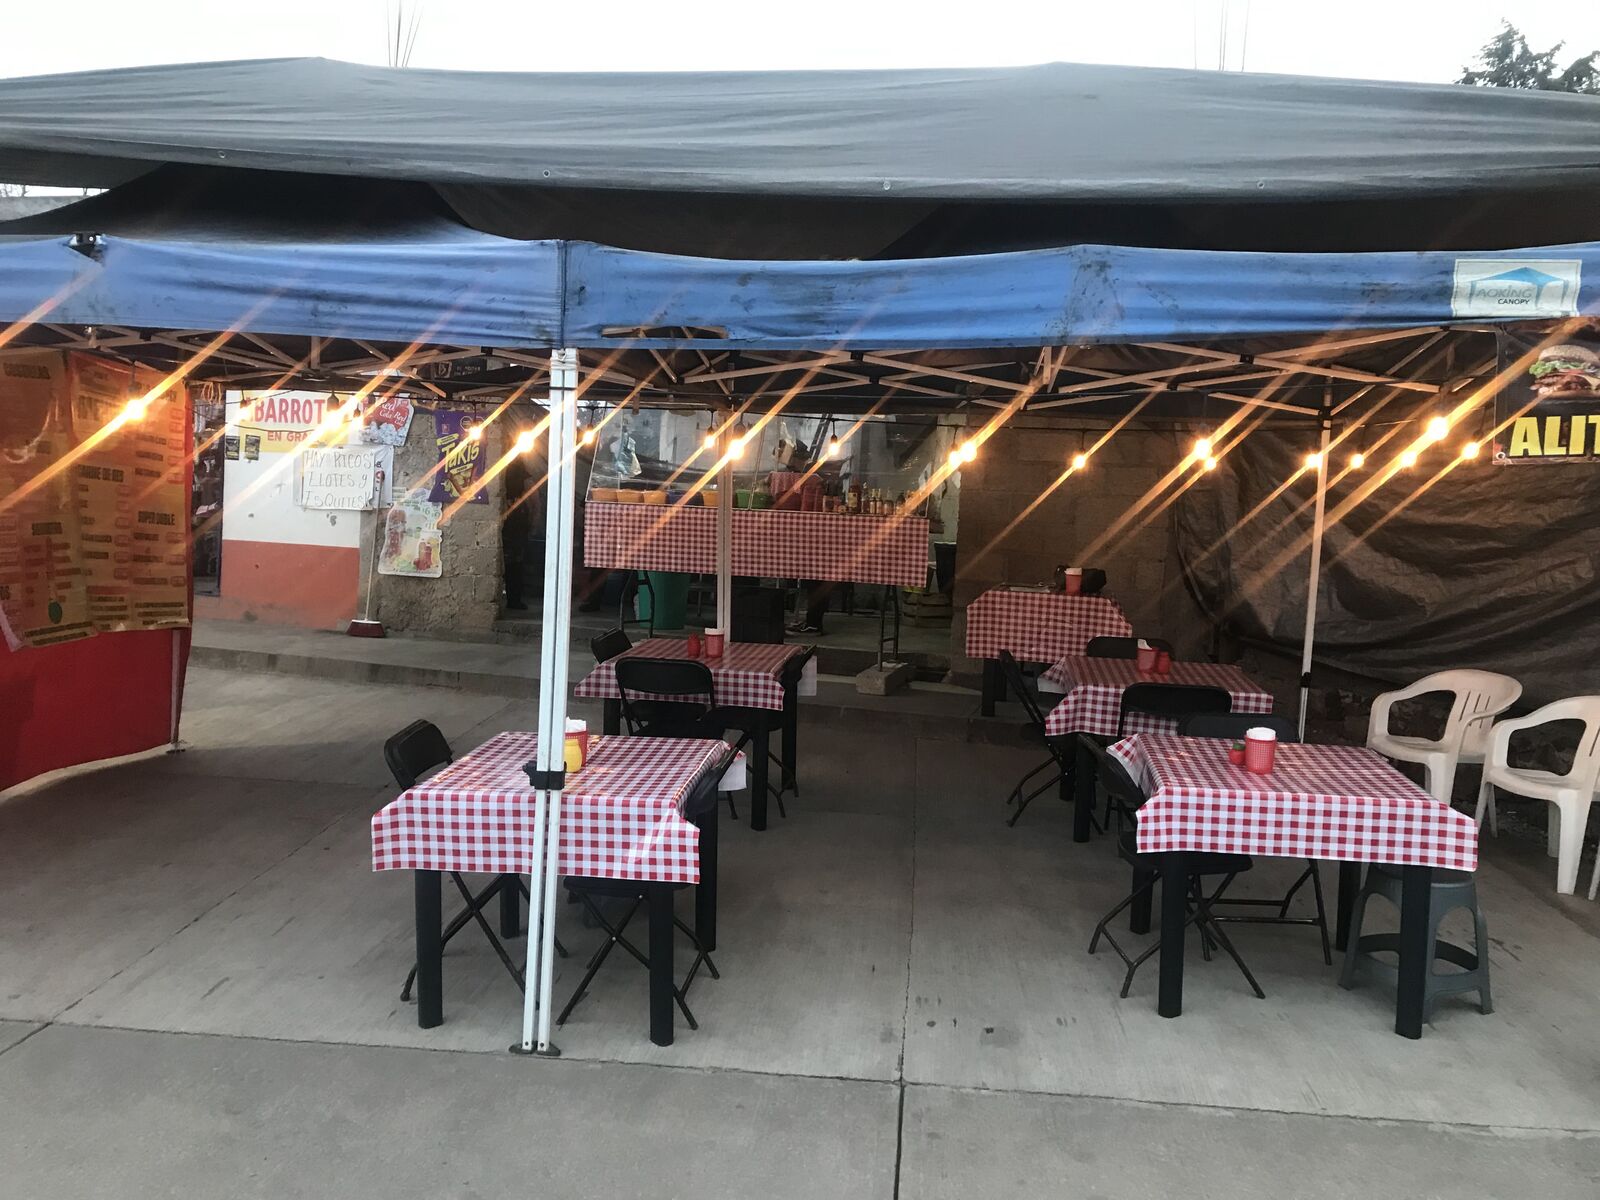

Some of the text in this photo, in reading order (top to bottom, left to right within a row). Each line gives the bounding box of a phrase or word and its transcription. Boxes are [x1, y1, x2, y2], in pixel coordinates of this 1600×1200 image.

[267, 431, 282, 442] EN
[304, 450, 372, 469] HAY RICOS
